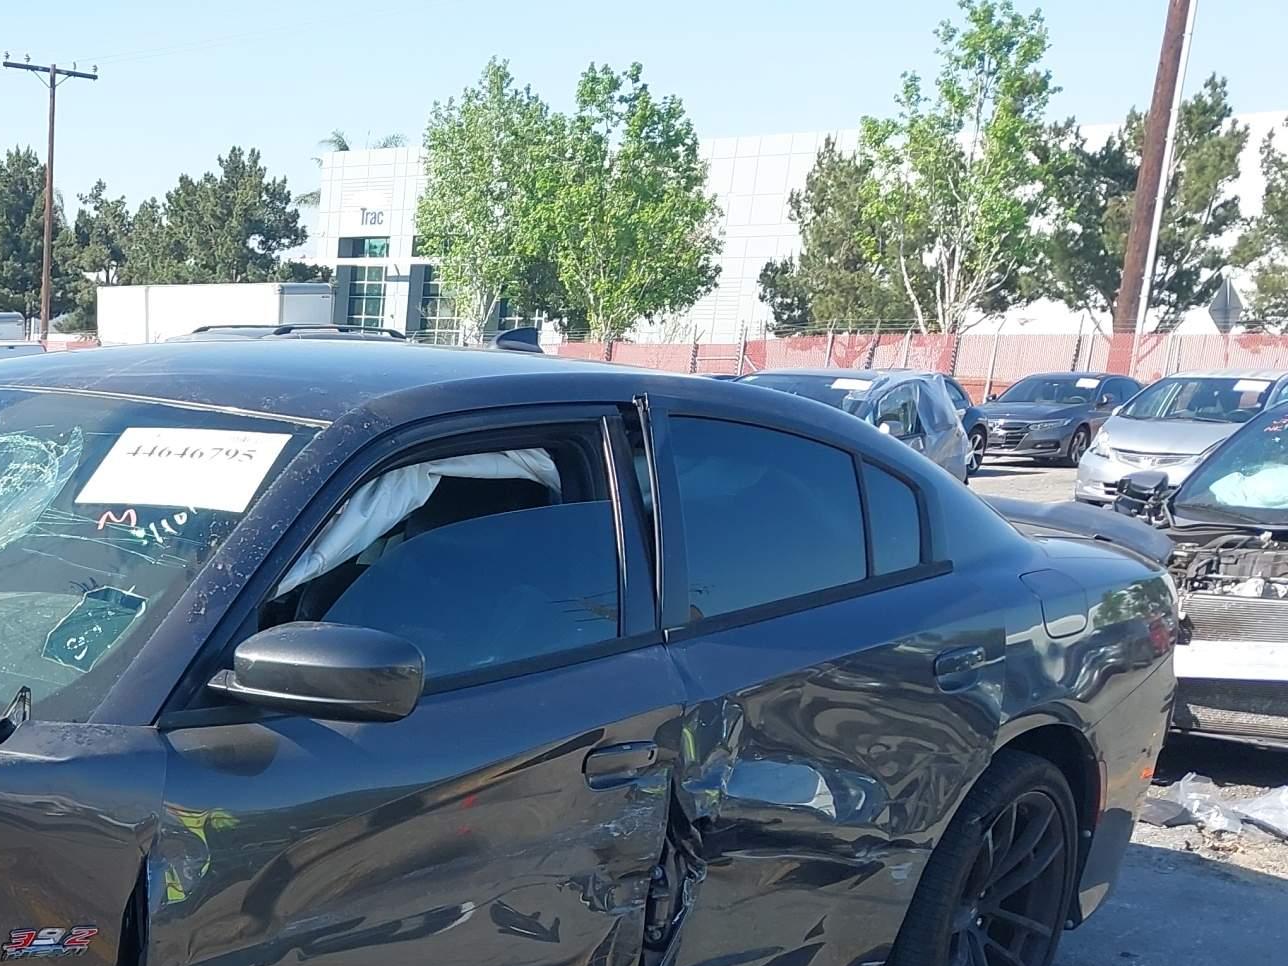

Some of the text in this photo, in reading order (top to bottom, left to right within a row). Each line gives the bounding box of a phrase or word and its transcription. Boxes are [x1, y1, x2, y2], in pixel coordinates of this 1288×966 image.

[360, 208, 384, 226] Trac
[126, 445, 257, 463] 44646795
[7, 925, 99, 950] 392
